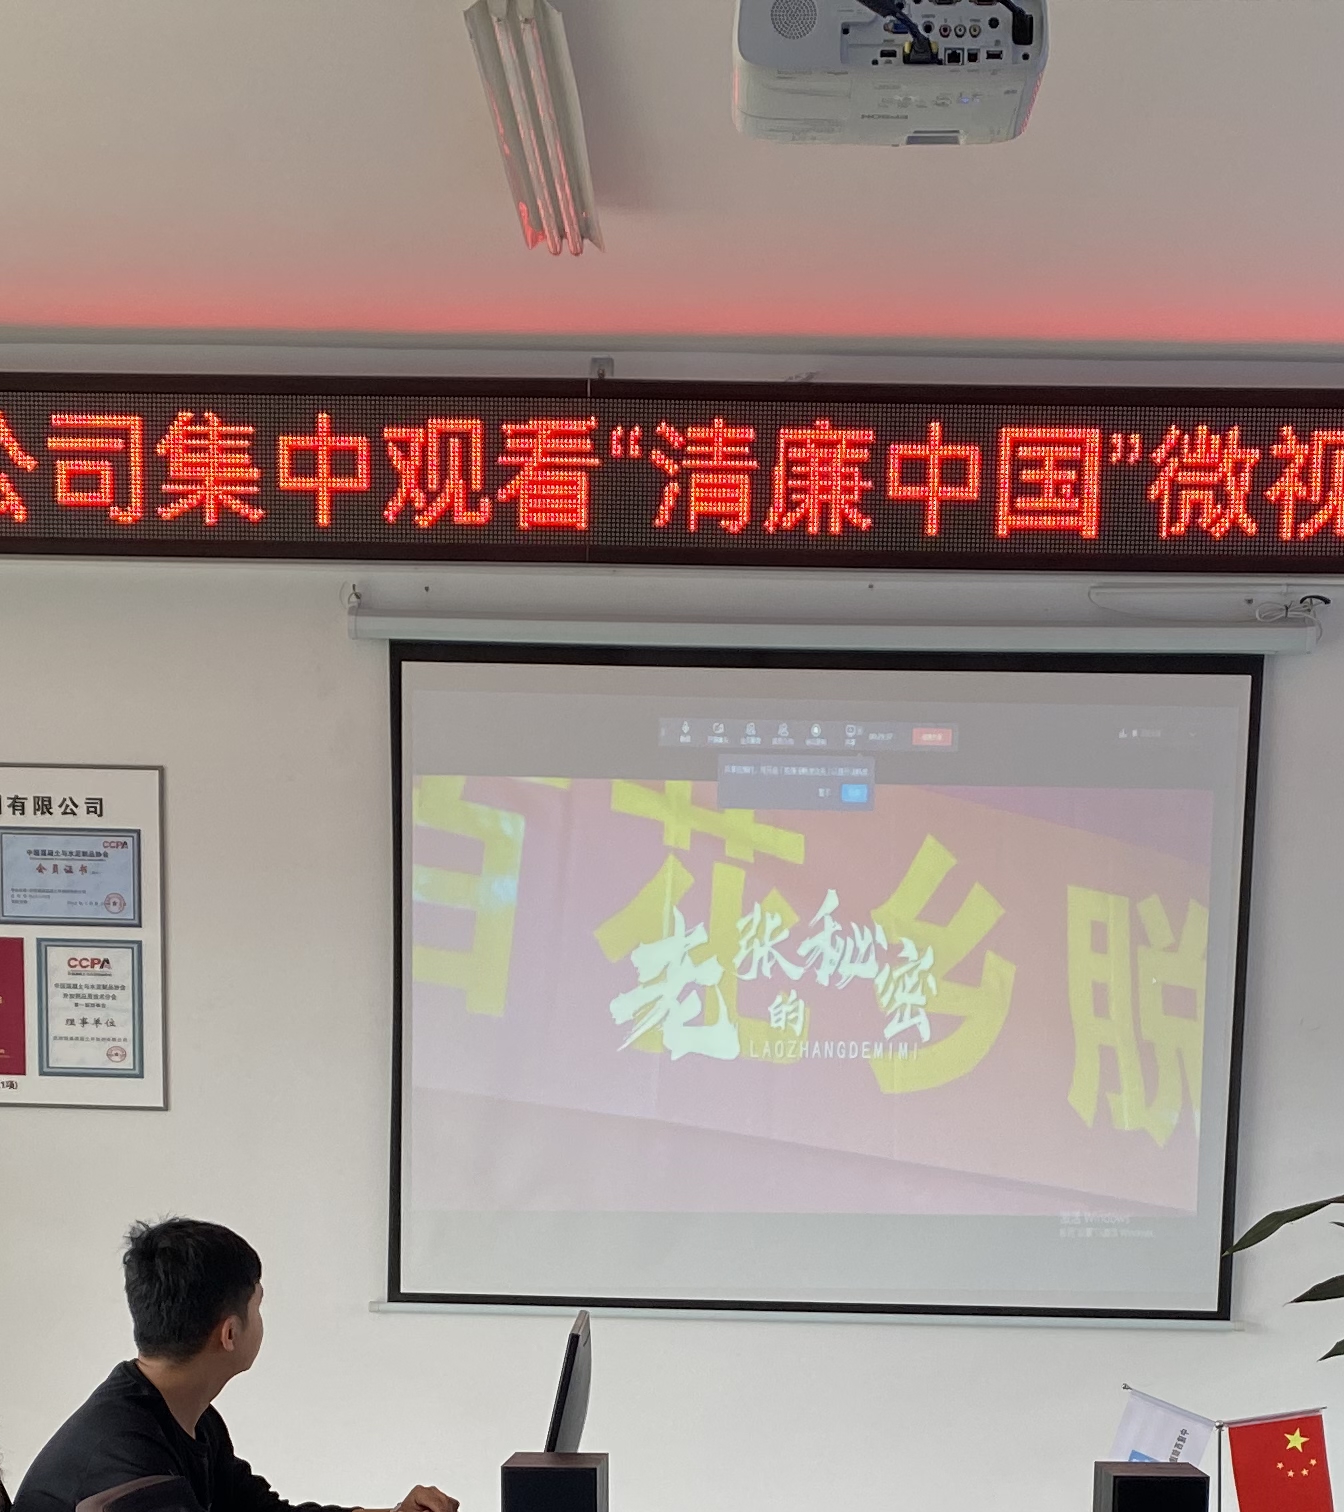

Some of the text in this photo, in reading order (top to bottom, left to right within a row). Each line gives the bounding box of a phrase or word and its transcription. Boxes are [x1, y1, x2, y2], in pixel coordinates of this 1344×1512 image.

[102, 840, 129, 850] CCPA
[67, 957, 112, 970] CCPA
[65, 1016, 117, 1028] 理事单位
[749, 1039, 920, 1061] LAOZHANGDEMIMI
